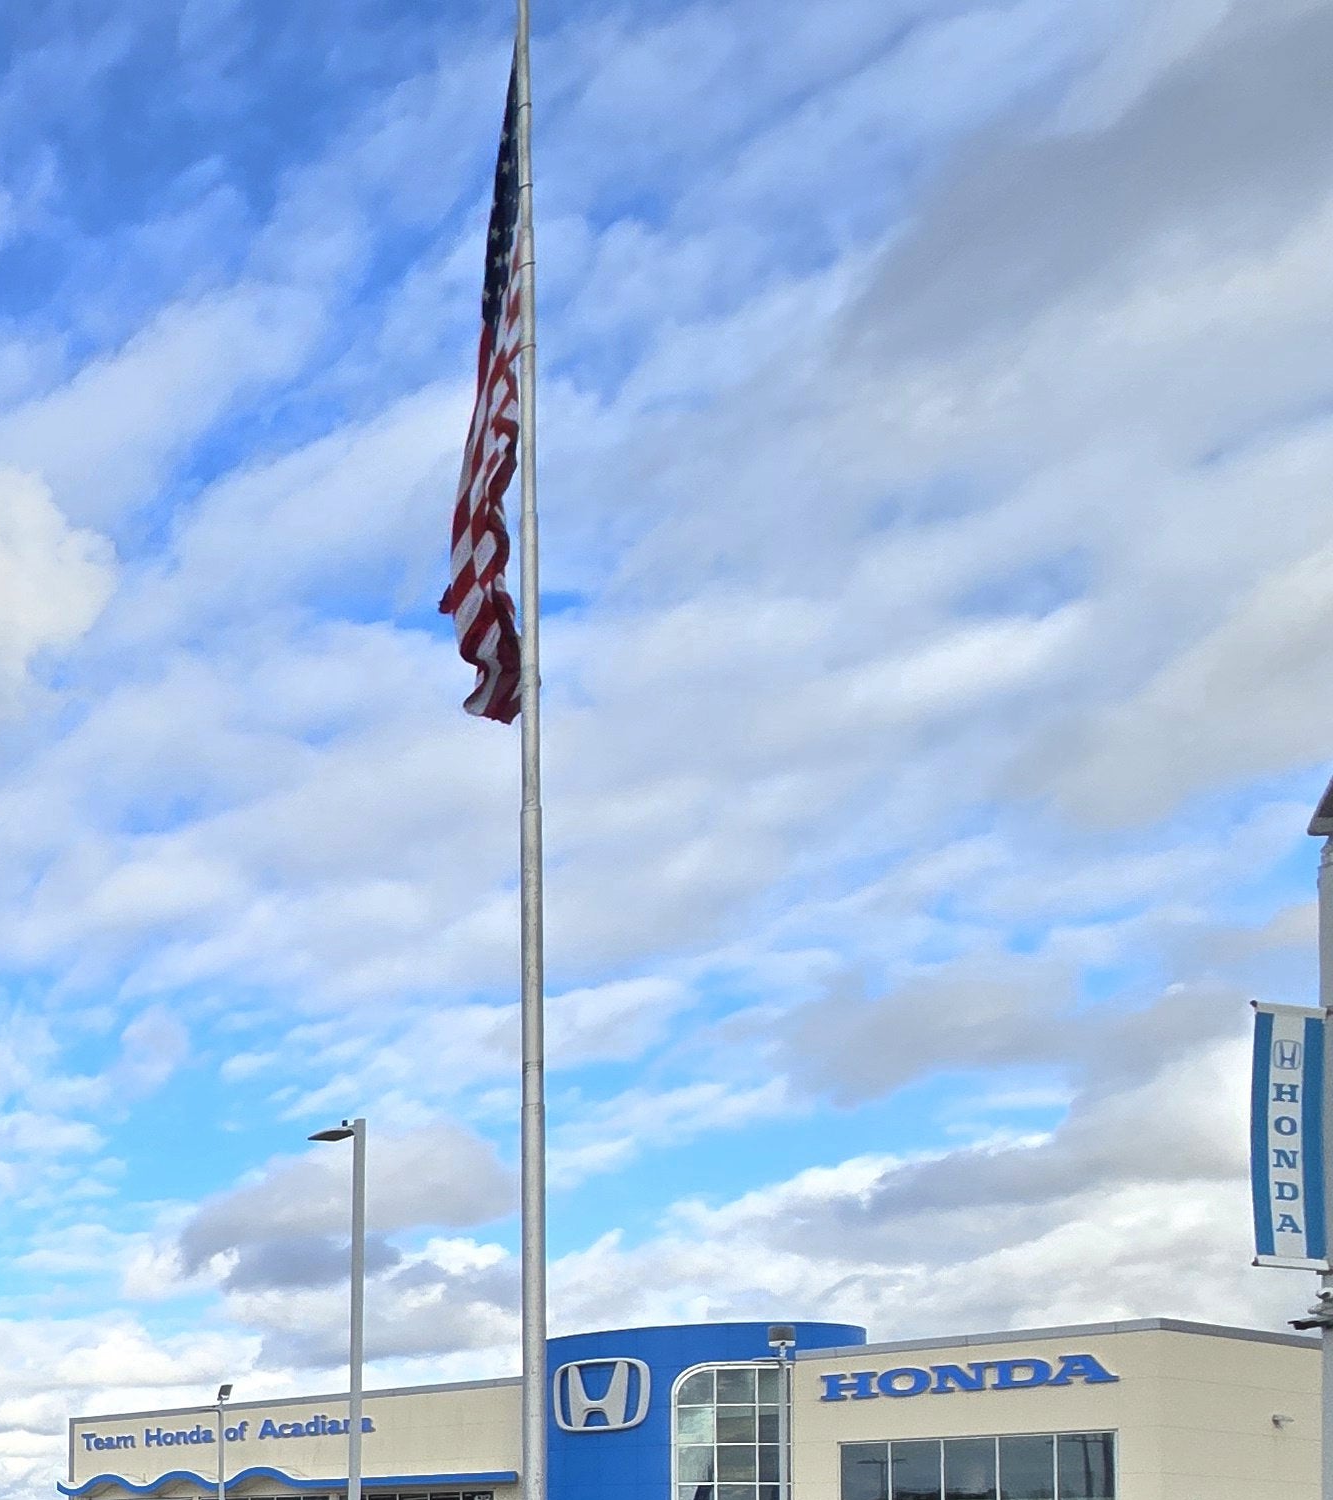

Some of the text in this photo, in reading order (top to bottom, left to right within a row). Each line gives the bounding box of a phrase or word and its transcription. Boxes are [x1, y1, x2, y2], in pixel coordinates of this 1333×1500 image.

[1272, 1083, 1302, 1234] HONDA
[819, 1354, 1121, 1402] HONDA
[81, 1432, 136, 1451] Team
[144, 1424, 216, 1447] Honda
[224, 1420, 250, 1442] of
